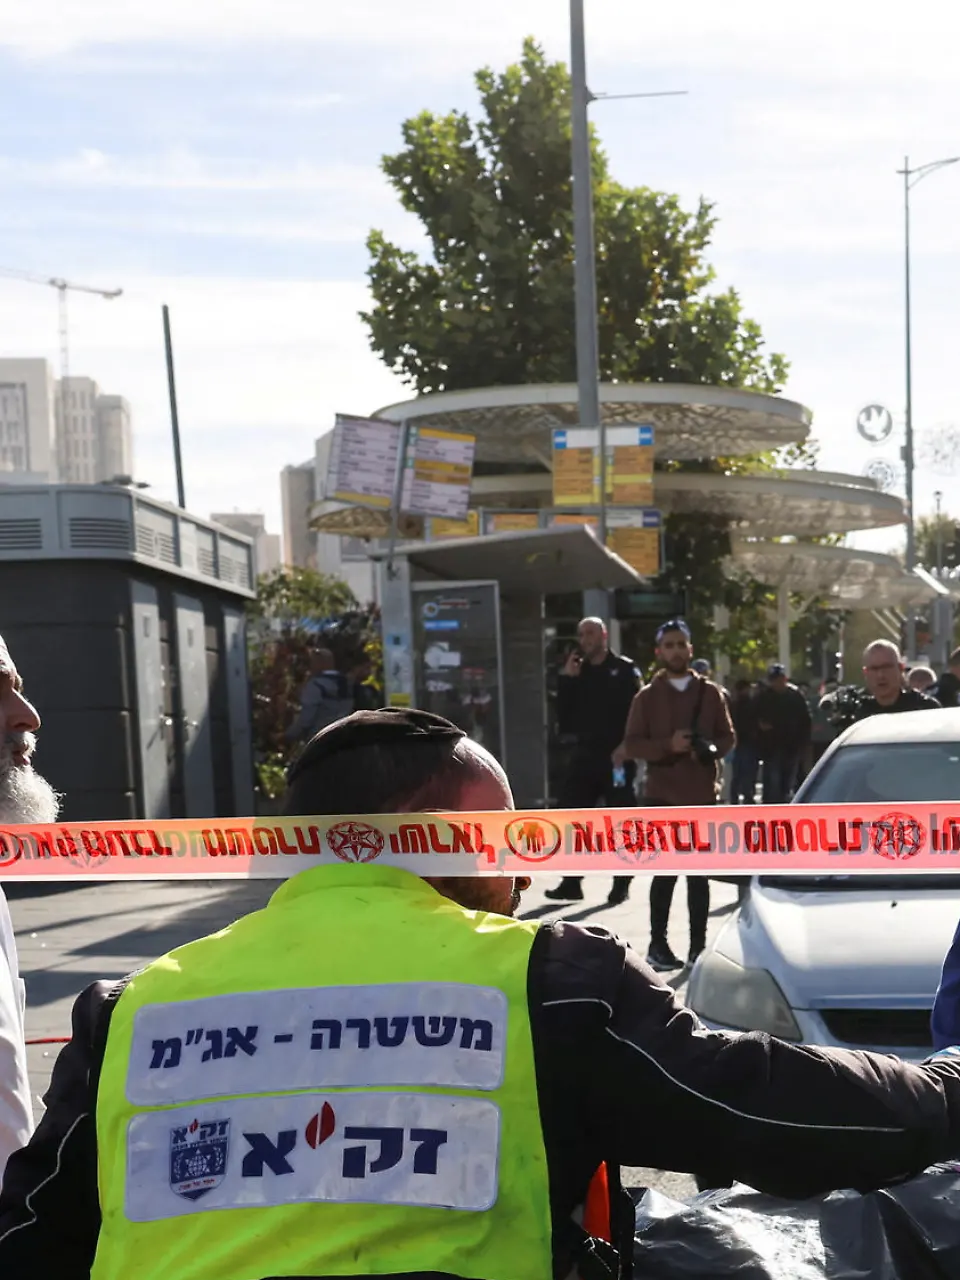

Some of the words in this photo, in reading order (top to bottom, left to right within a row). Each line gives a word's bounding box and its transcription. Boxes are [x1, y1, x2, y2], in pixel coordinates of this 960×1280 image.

[201, 825, 322, 856] משטרת
[389, 822, 496, 863] ישראל
[744, 817, 863, 853] משטרת
[149, 1025, 259, 1070] אג"מ
[273, 1033, 294, 1044] -
[310, 1015, 493, 1052] משטרה
